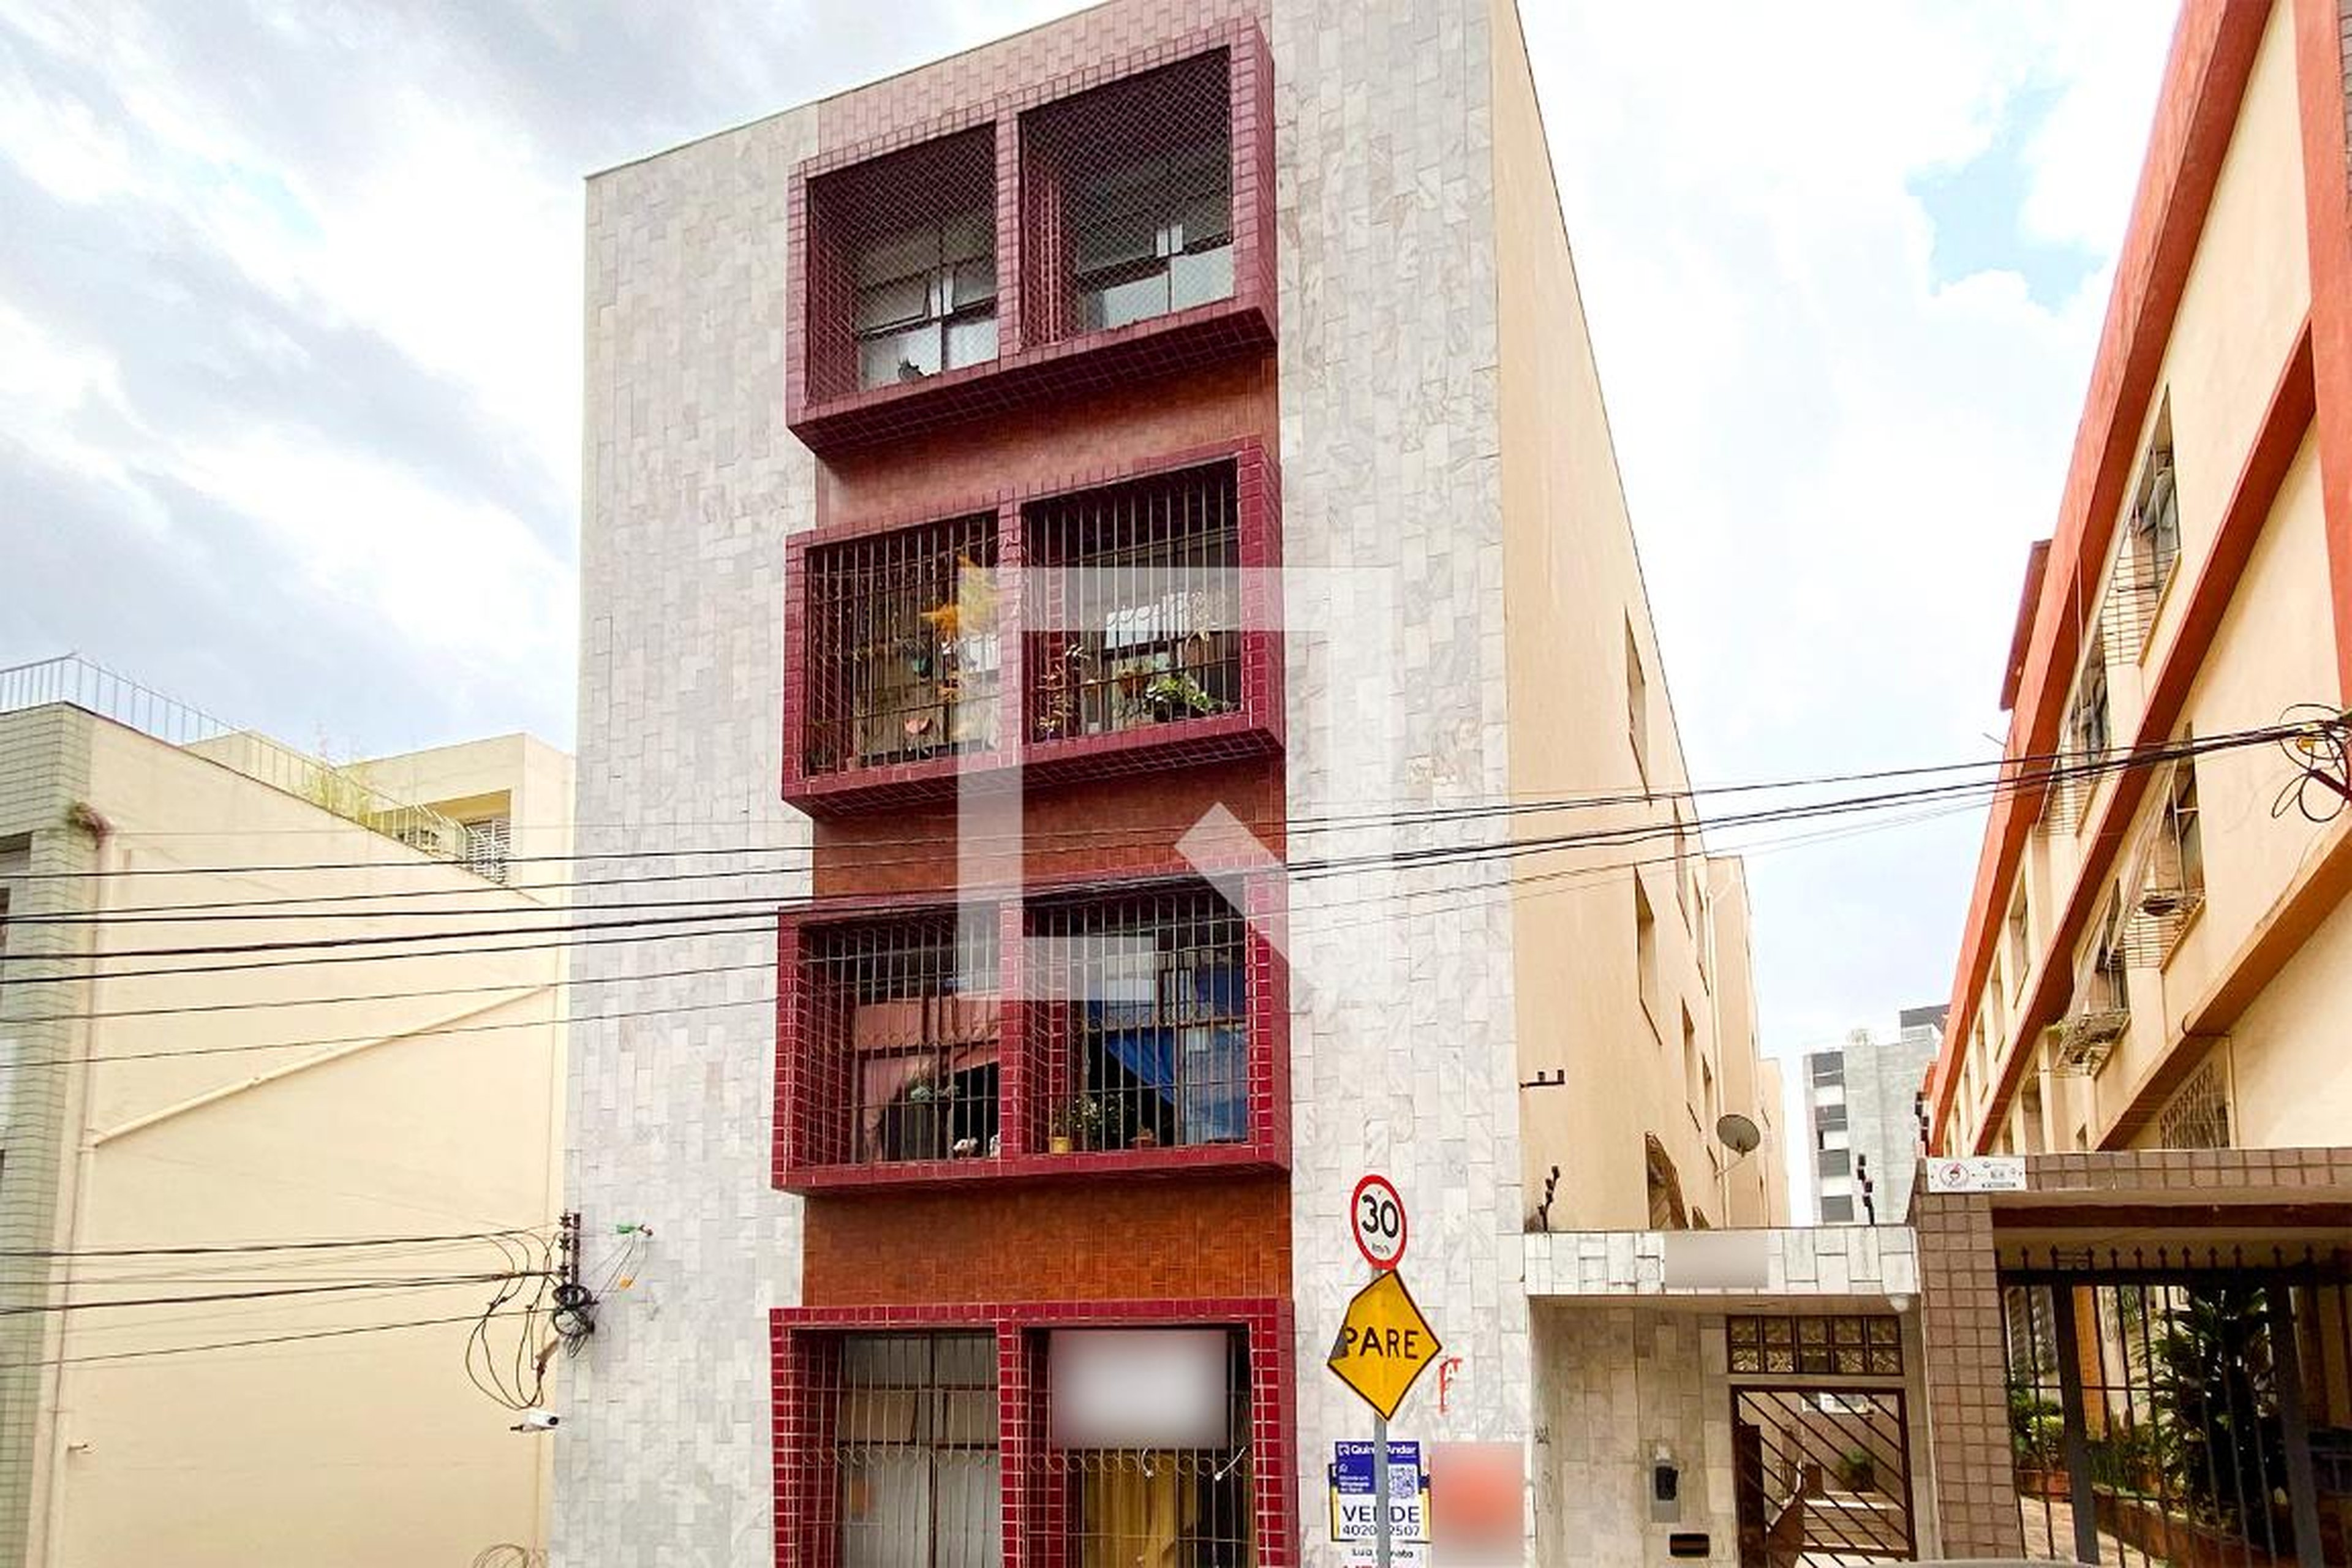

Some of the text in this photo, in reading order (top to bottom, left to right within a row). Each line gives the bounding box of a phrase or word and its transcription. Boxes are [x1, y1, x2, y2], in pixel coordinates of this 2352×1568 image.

[1362, 1194, 1399, 1238] 30
[1342, 1326, 1419, 1360] PARE
[1342, 1505, 1420, 1523] VEDE
